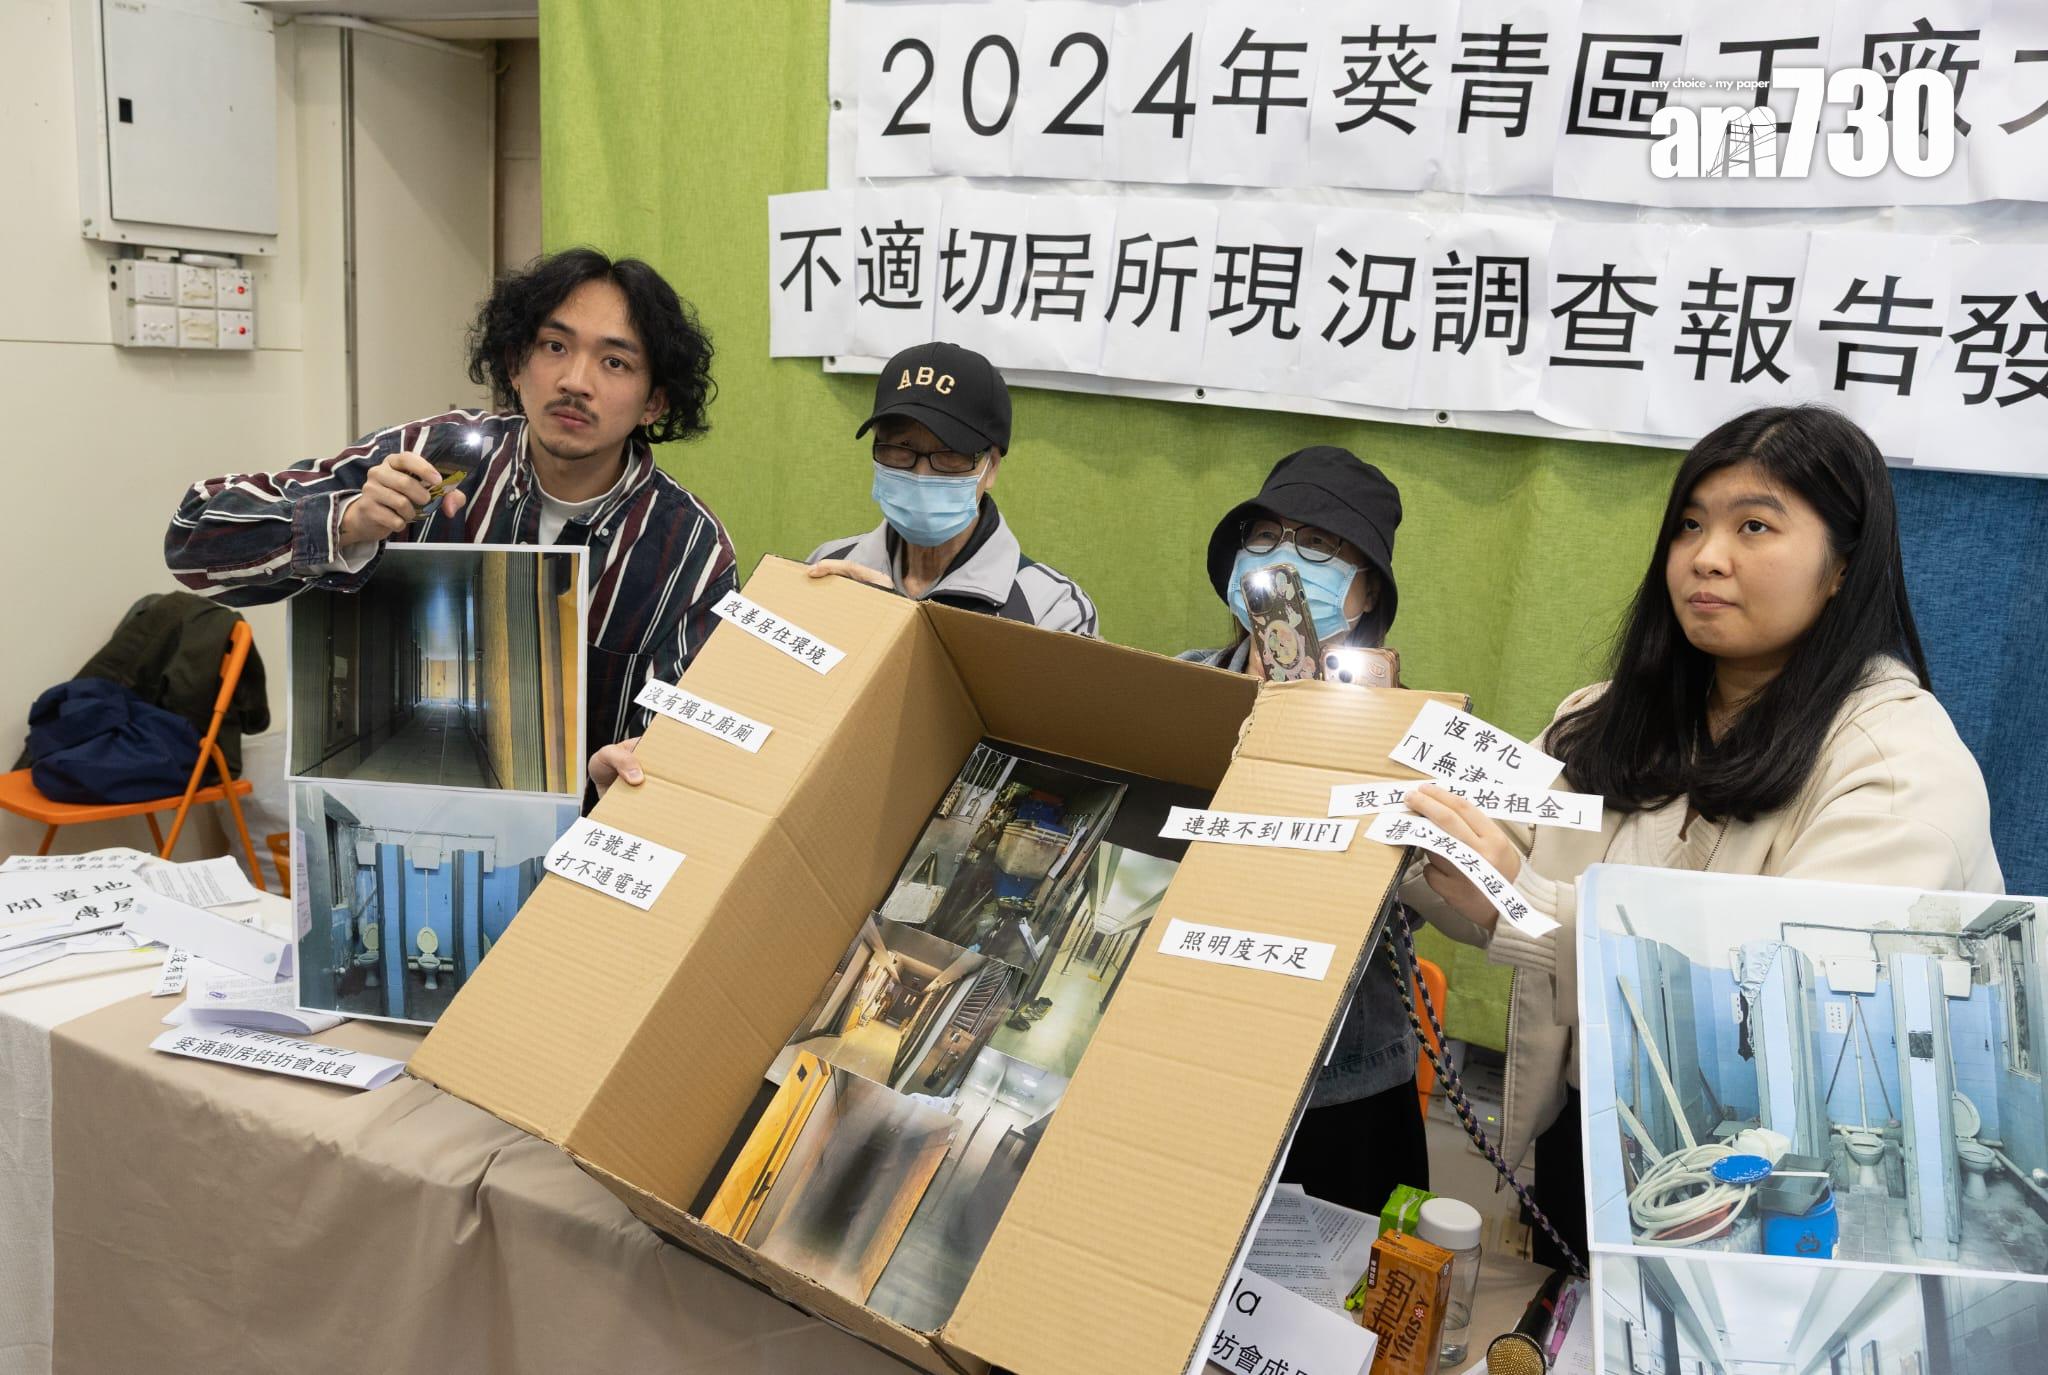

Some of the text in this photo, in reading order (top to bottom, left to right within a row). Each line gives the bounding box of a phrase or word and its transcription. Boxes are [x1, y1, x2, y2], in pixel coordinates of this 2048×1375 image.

[780, 219, 2048, 408] 不適切居所現況調查報告發
[897, 366, 955, 394] ABC
[723, 600, 827, 667] 改善居住環境
[643, 686, 756, 743] 沒有獨立廚廁
[1402, 734, 1504, 784] 「N無津
[1181, 815, 1343, 845] 連接不到 WIFI
[554, 851, 652, 900] 打不通電話
[1179, 931, 1309, 970] 照明度不足
[172, 1035, 356, 1079] 葵涌劏房街坊會成員
